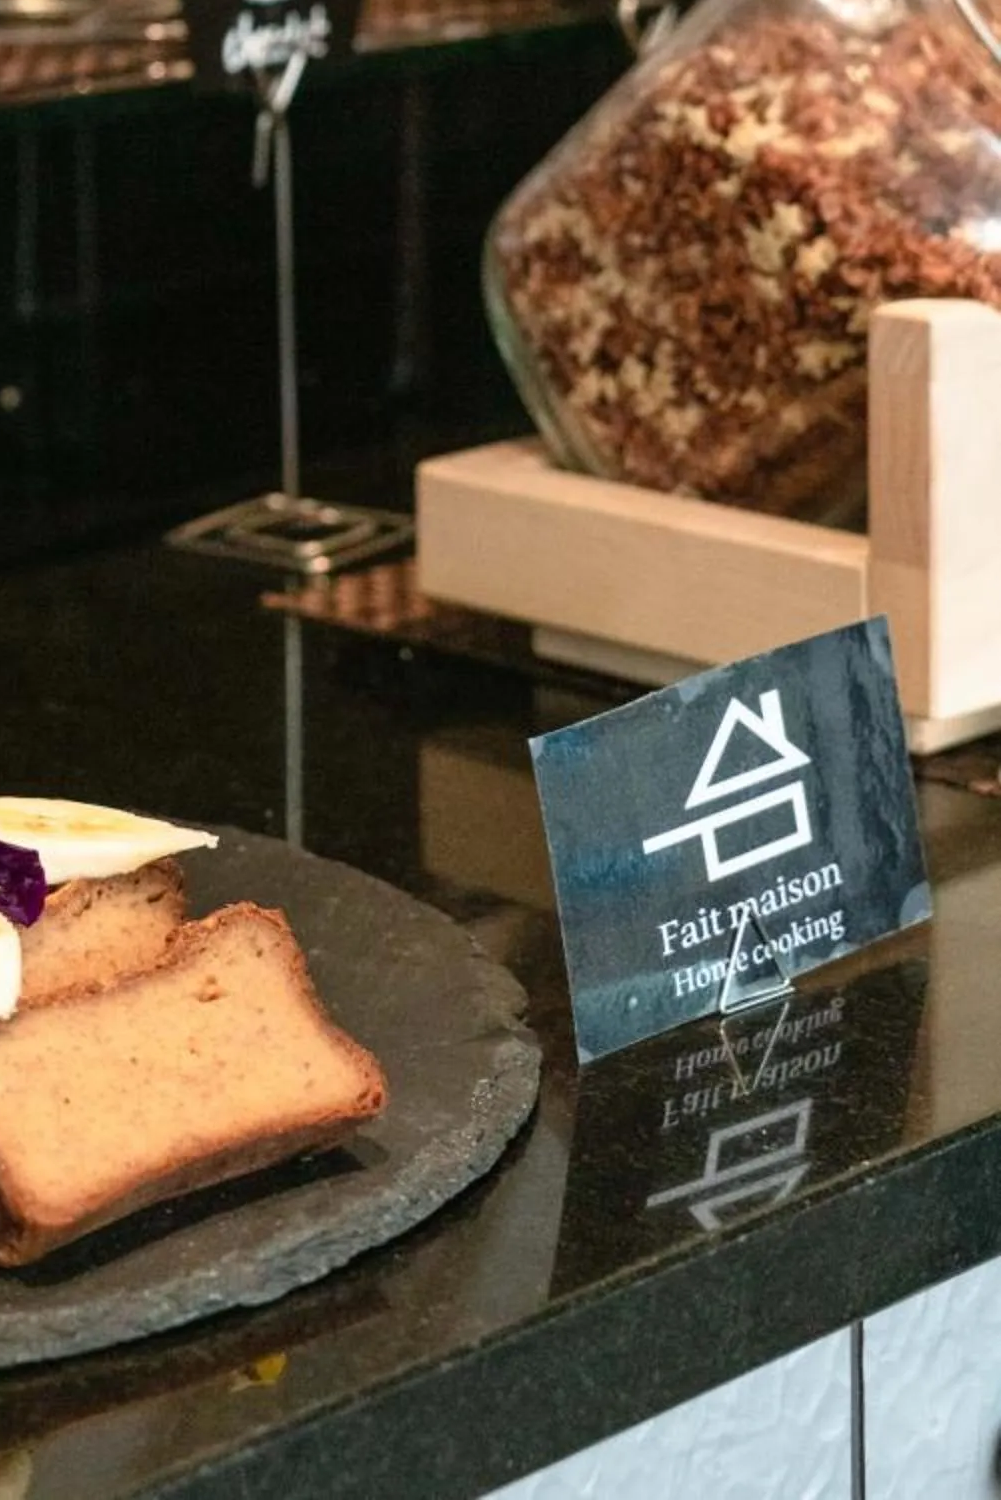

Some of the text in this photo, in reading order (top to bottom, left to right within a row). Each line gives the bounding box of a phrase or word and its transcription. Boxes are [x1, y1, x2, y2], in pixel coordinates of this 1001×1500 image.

[658, 862, 843, 956] Fait maison
[673, 910, 846, 997] Home cooking
